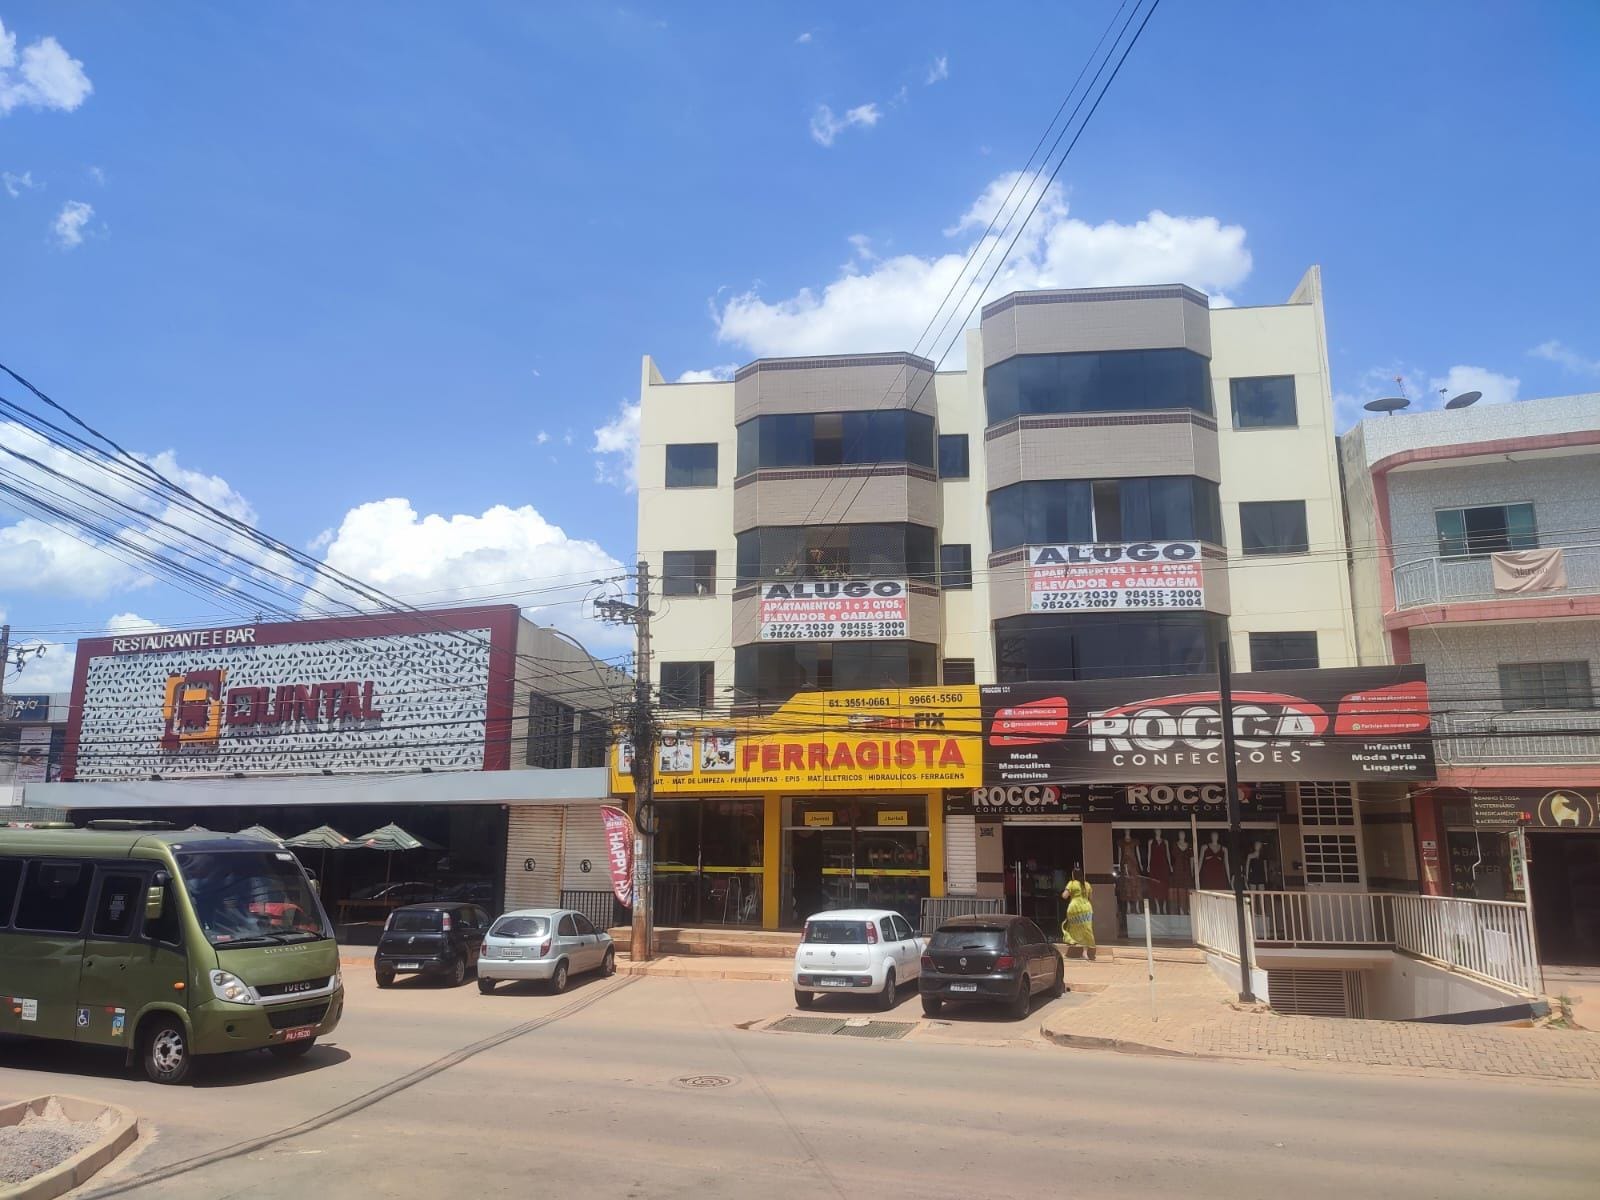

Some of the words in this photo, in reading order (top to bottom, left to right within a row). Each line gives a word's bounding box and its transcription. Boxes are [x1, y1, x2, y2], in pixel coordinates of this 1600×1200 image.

[1035, 543, 1196, 565] ALUGO
[1034, 566, 1126, 578] APARTAMENTOS
[1130, 566, 1135, 575] 1
[1151, 565, 1159, 574] 2
[1034, 578, 1107, 590] ELEVADOR
[1111, 580, 1120, 588] e
[1125, 577, 1197, 588] GARAGEM
[765, 581, 902, 599] ALUGO
[1125, 590, 1202, 599] 98455-2000
[764, 601, 842, 611] APARTAMENTOS
[845, 600, 850, 610] 1
[863, 600, 870, 610] 2
[872, 599, 902, 610] QTOS.
[1041, 600, 1117, 609] 98262-2007
[1125, 599, 1202, 607] 99955-2004
[764, 611, 826, 622] ELEVADOR
[829, 613, 837, 621] e
[841, 610, 902, 620] GARAGEM
[770, 623, 835, 631] 3797-2030
[770, 630, 834, 638] 98262-2007
[112, 631, 210, 653] RESTAURANTE
[213, 630, 222, 645] E
[225, 628, 256, 643] BAR
[225, 680, 383, 725] QUINTAL
[908, 693, 963, 704] 99661-5560
[1088, 705, 1326, 752] ROCCA
[742, 738, 966, 772] FERRAGISTA
[1362, 764, 1417, 772] Lingerie
[730, 775, 778, 784] FERRAMENTAS
[973, 785, 1059, 806] ROCCA
[609, 832, 627, 876] HAPPY
[284, 982, 310, 993] IVECO
